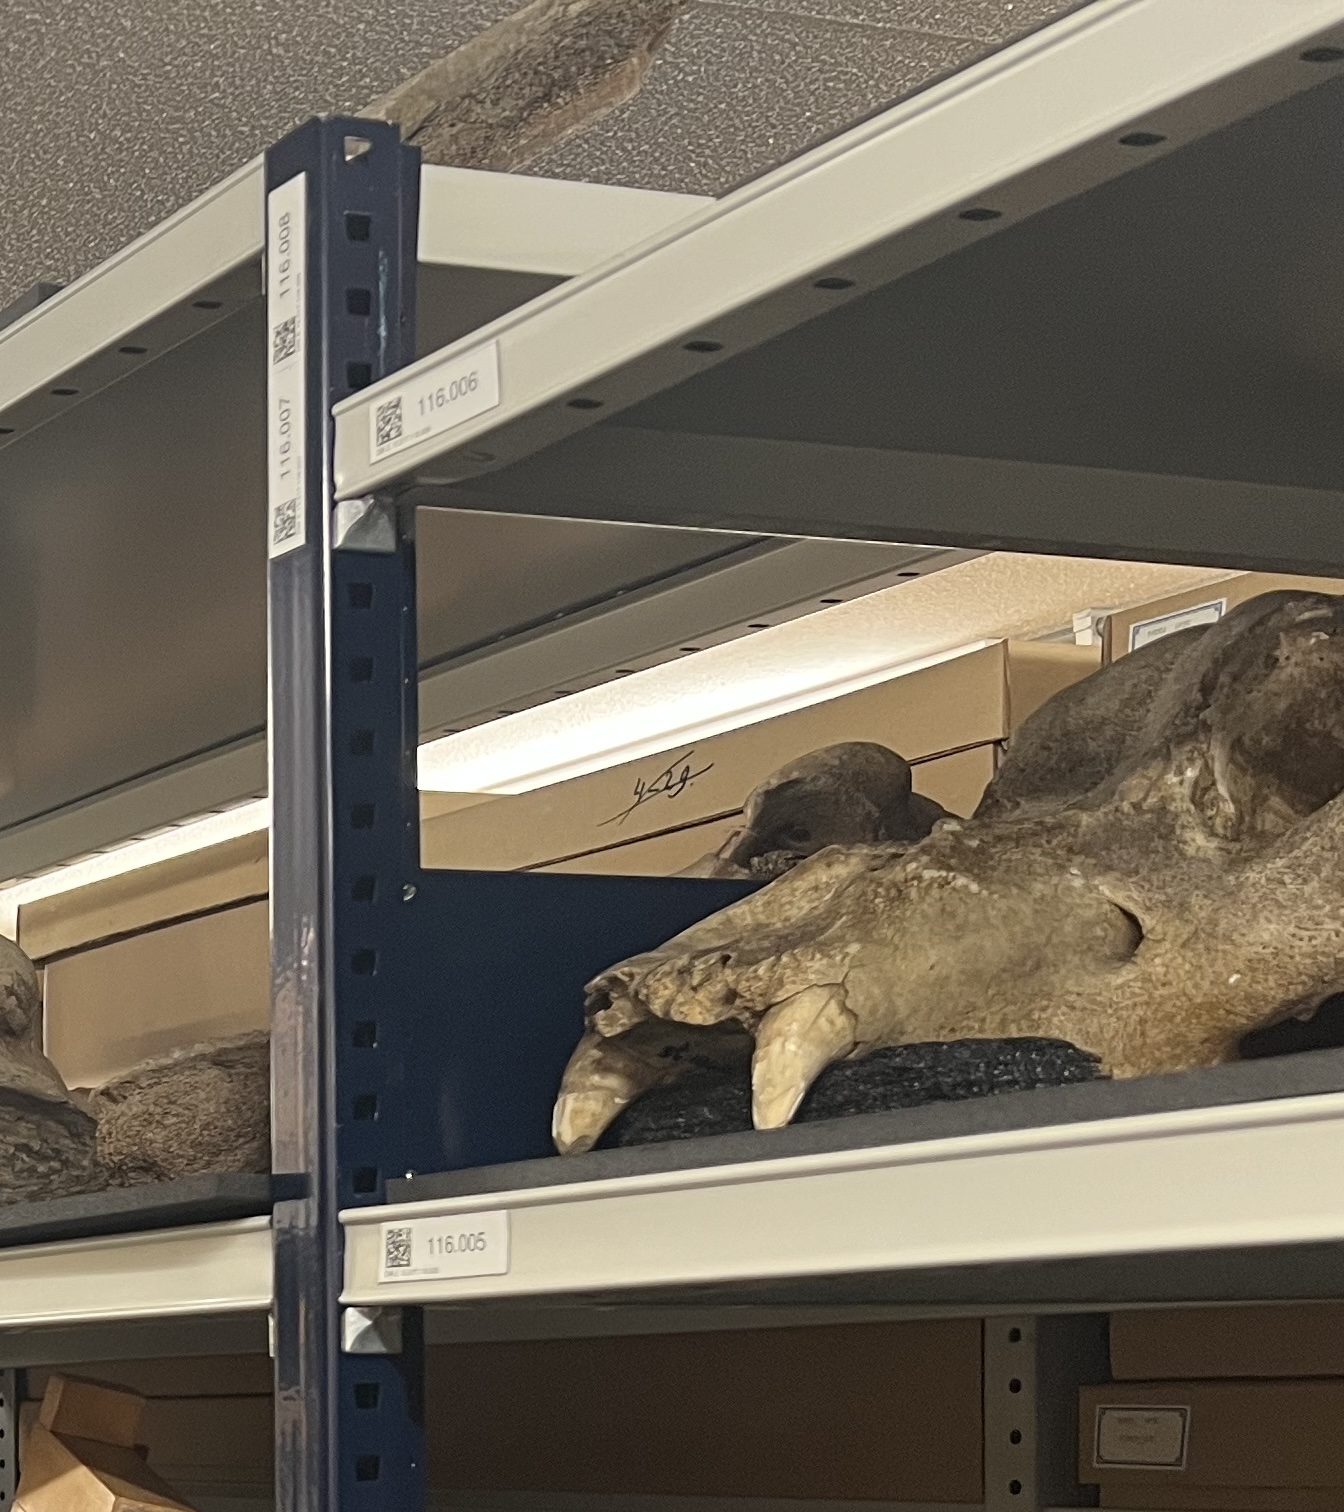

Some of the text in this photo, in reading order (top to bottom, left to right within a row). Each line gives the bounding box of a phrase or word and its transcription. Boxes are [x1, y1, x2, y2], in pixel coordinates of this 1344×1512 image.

[279, 212, 291, 299] 116.008
[418, 370, 479, 416] 116.006
[279, 397, 292, 480] 116.007
[428, 1231, 487, 1256] 116.005
